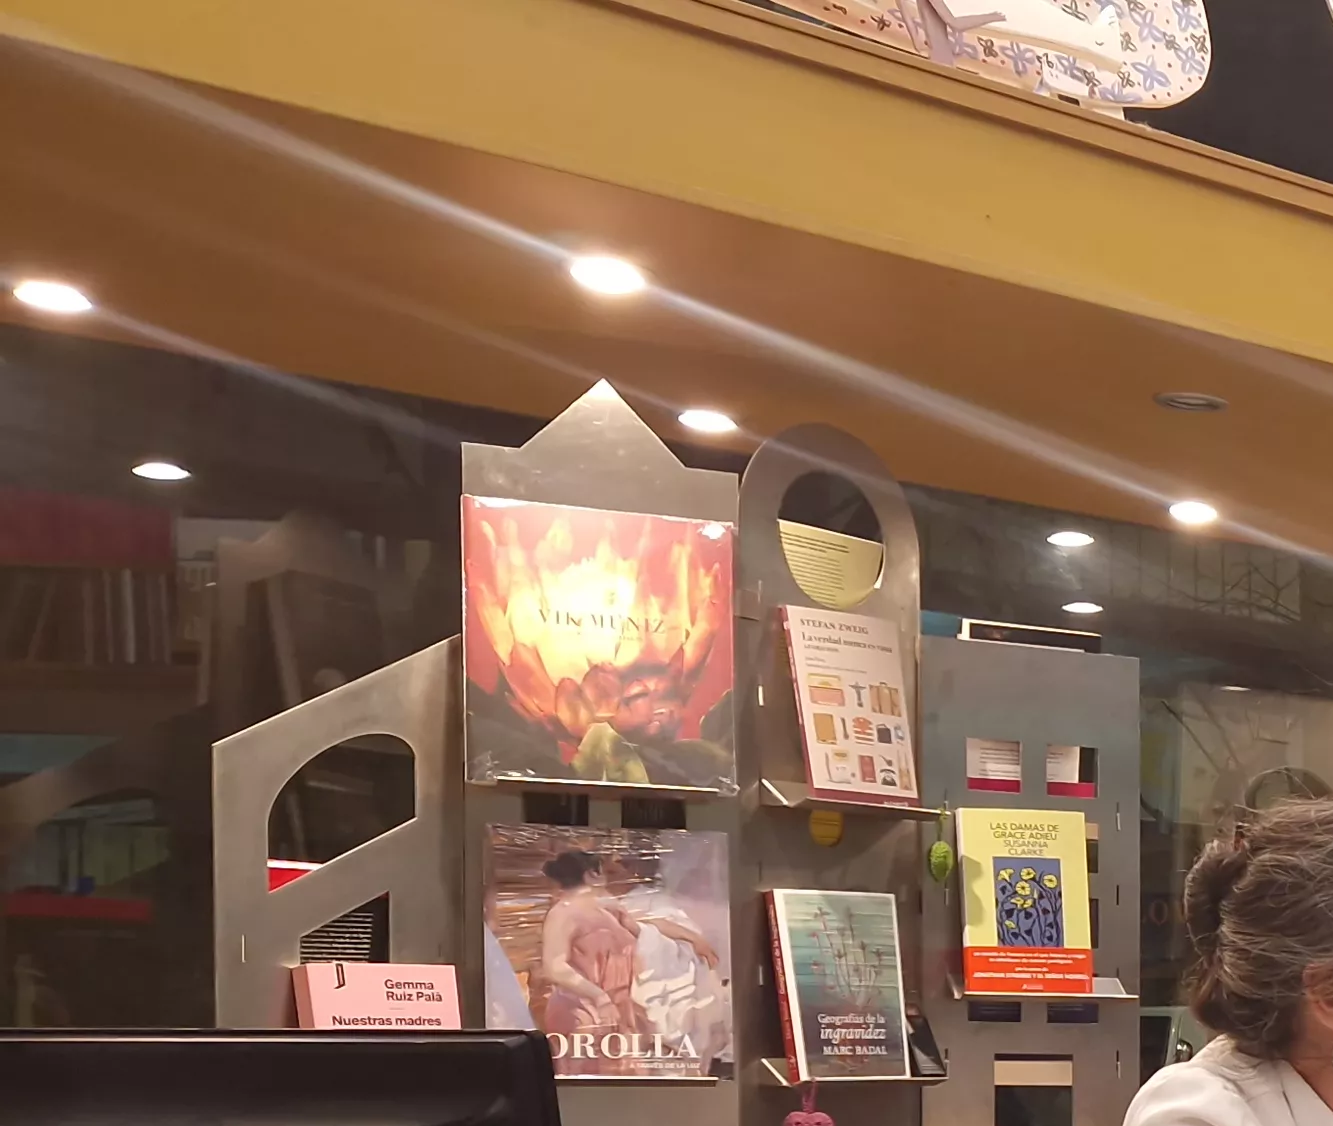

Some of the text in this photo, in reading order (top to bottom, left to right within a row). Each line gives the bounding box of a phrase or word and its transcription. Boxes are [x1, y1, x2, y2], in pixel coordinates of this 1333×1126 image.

[800, 618, 869, 635] STEFAN ZWEIG
[990, 822, 1007, 831] LAS
[1010, 823, 1045, 832] DAMAS
[993, 831, 1057, 840] GRACE ADIEU
[1004, 840, 1048, 848] SUSANNA
[384, 979, 434, 990] Gemma
[386, 991, 412, 1001] Ruiz
[332, 1015, 441, 1026] Nuestras madres
[865, 1014, 875, 1023] de
[877, 1014, 885, 1023] la
[820, 1025, 886, 1043] ingravidez
[546, 1032, 700, 1059] OROLLA
[823, 1046, 888, 1055] MARC BADAL
